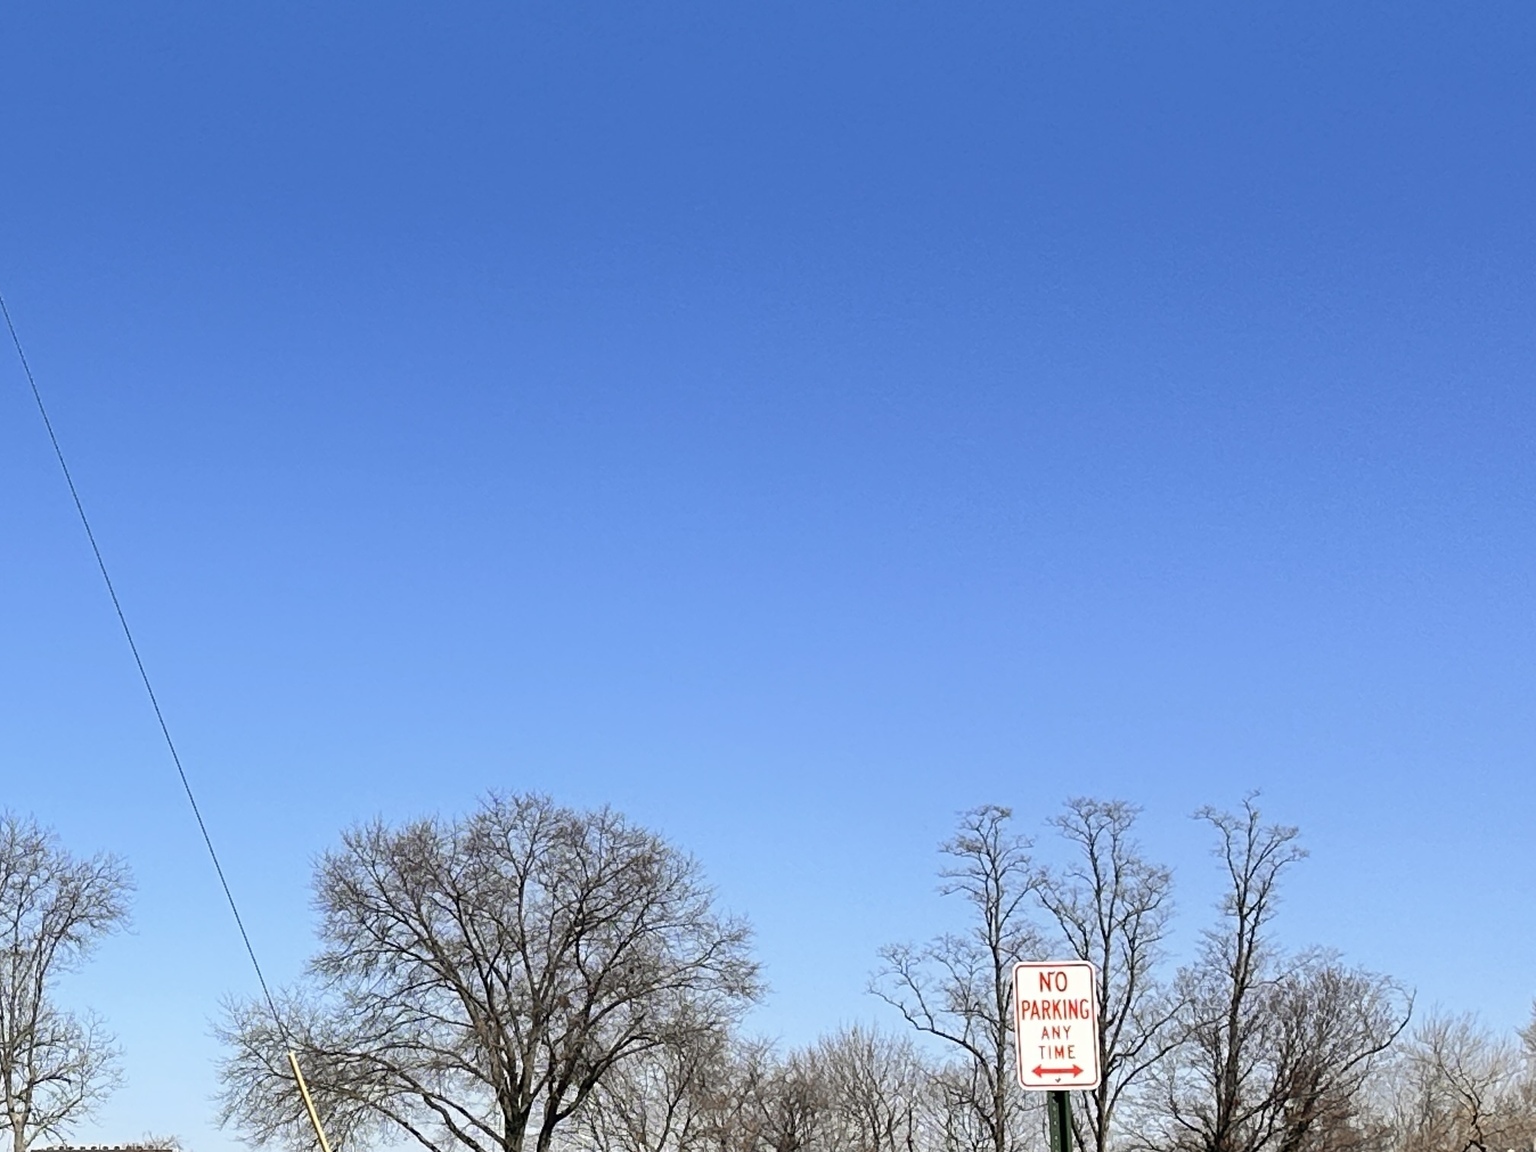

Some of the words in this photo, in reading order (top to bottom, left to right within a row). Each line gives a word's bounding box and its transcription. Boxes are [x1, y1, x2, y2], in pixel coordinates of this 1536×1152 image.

[1039, 971, 1068, 992] NO
[1021, 999, 1090, 1021] PARKING
[1041, 1025, 1072, 1040] ANY
[1038, 1045, 1076, 1060] TIME
